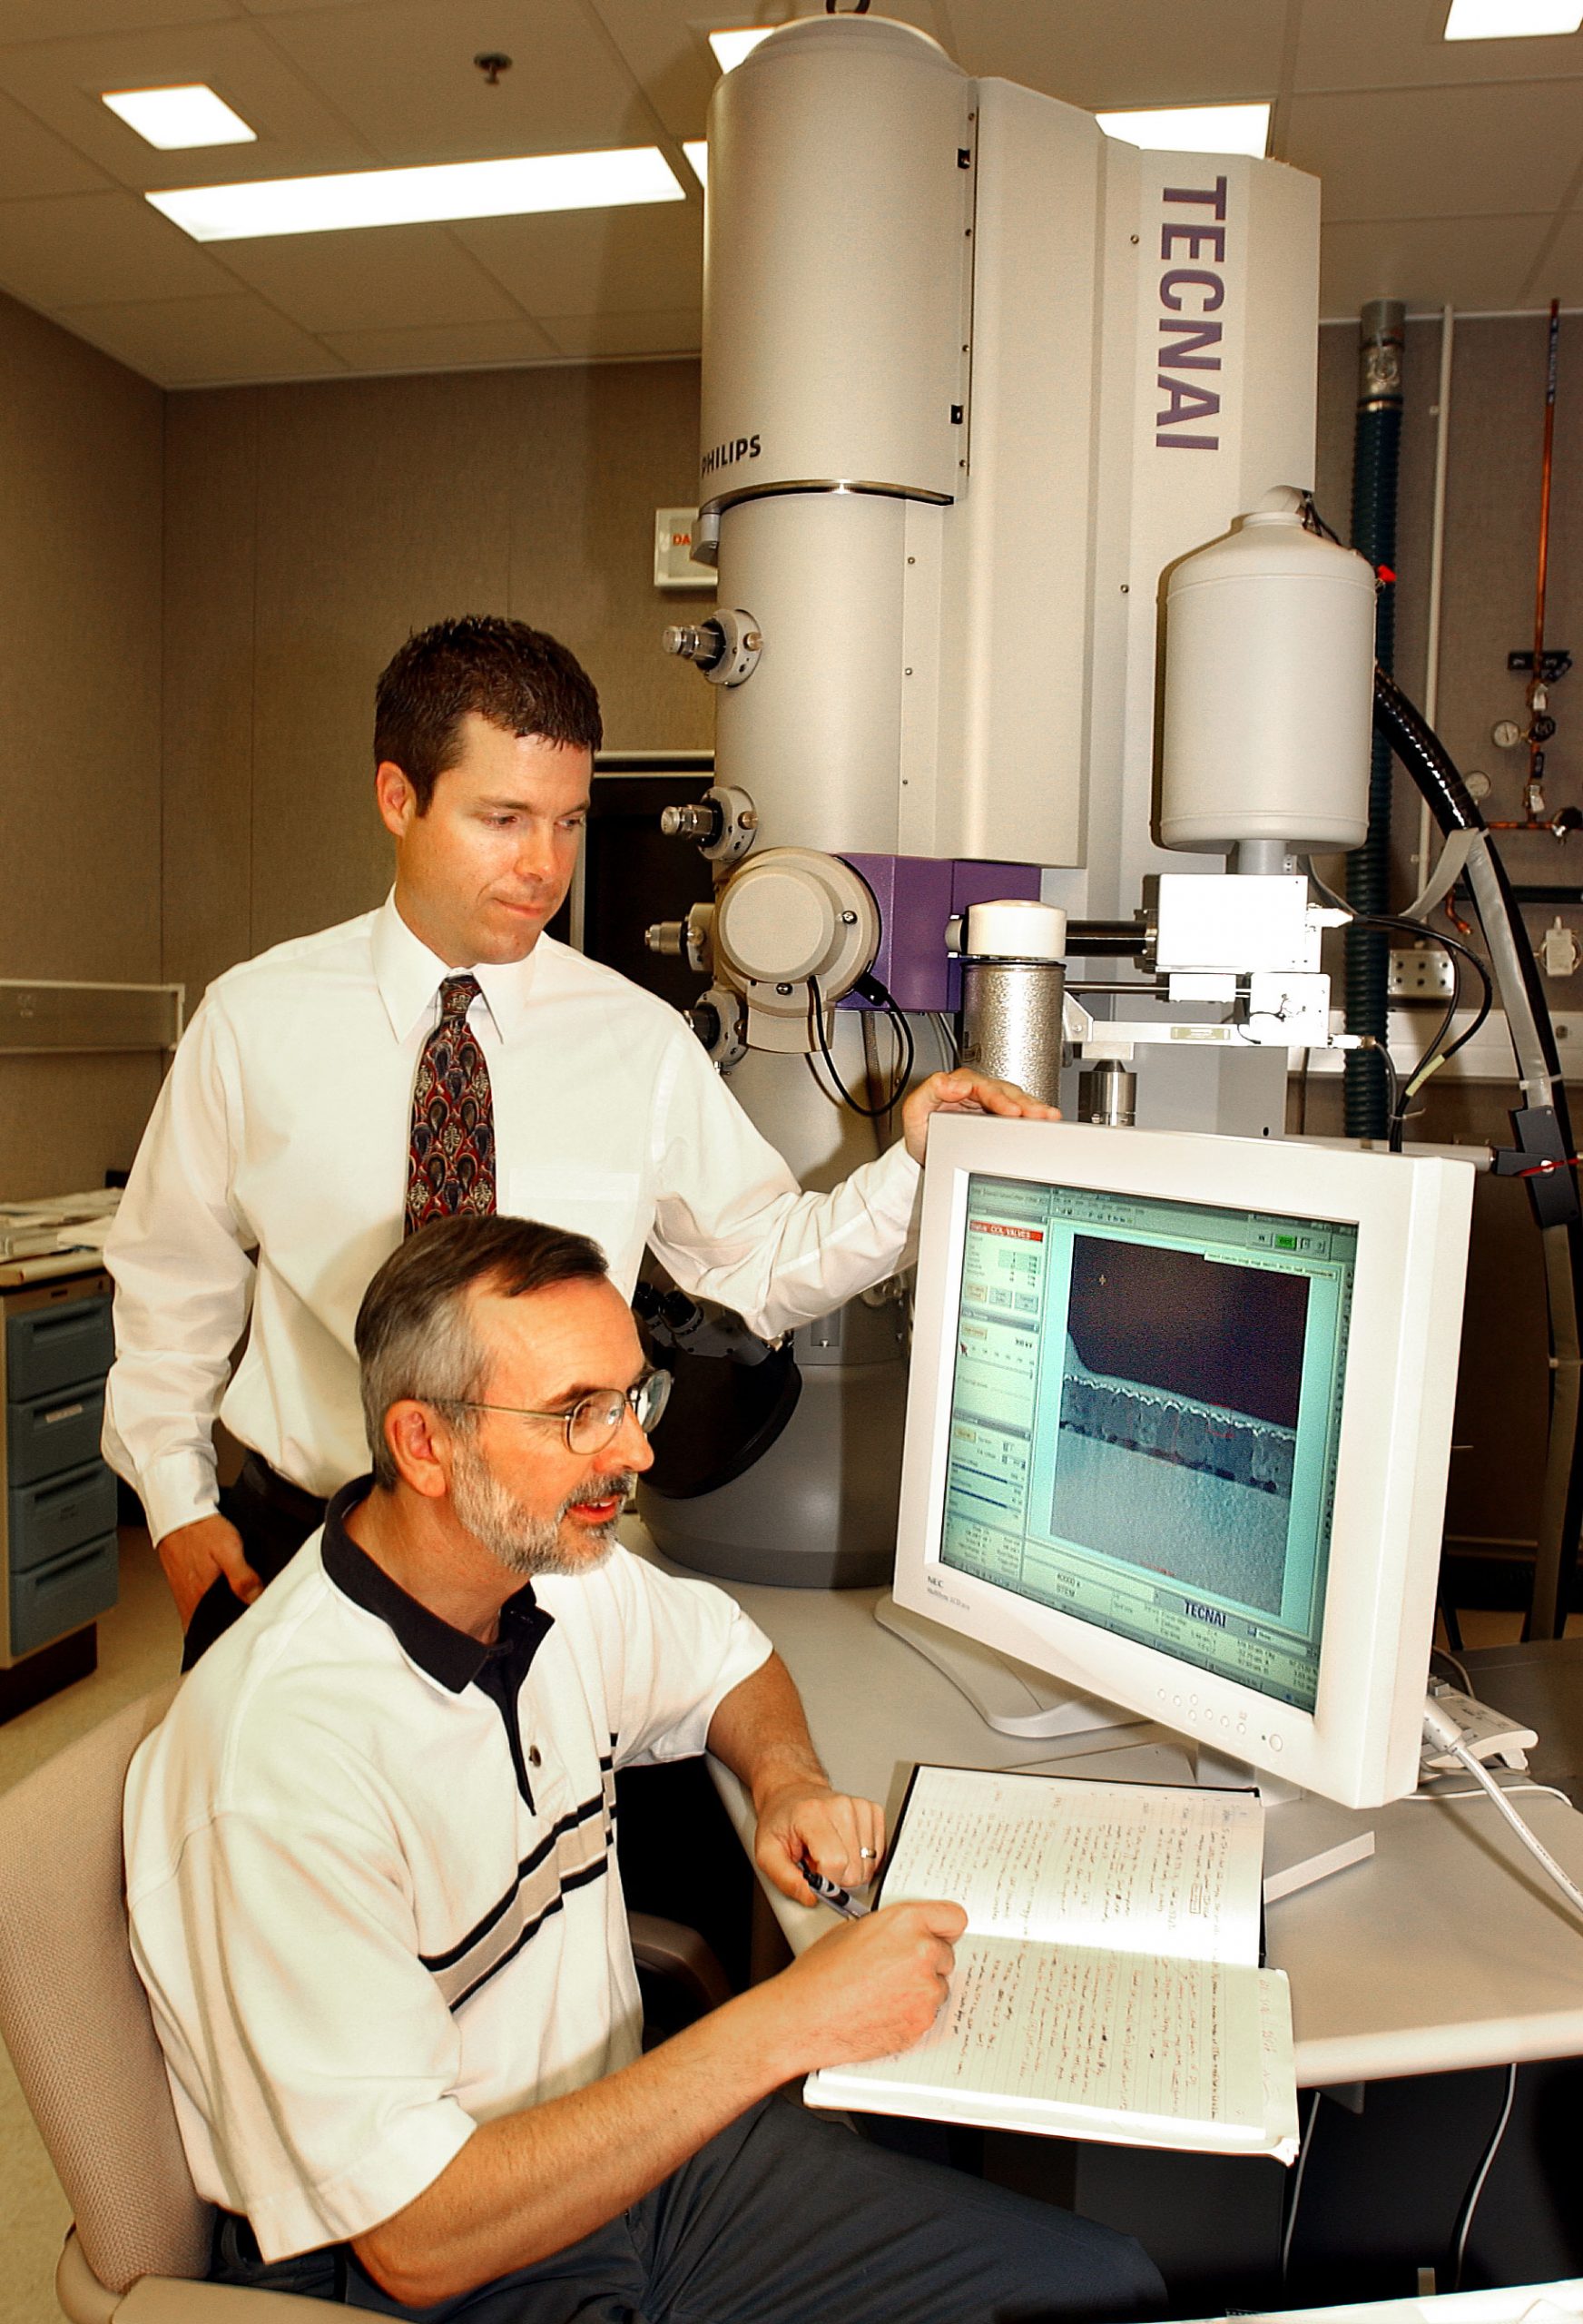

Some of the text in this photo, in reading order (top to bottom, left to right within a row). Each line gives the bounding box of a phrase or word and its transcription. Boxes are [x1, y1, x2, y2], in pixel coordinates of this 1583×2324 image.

[1156, 176, 1227, 450] TECNAI
[701, 434, 762, 479] PHILIPS
[927, 1575, 944, 1588] NEC
[1184, 1600, 1228, 1629] TECNAI
